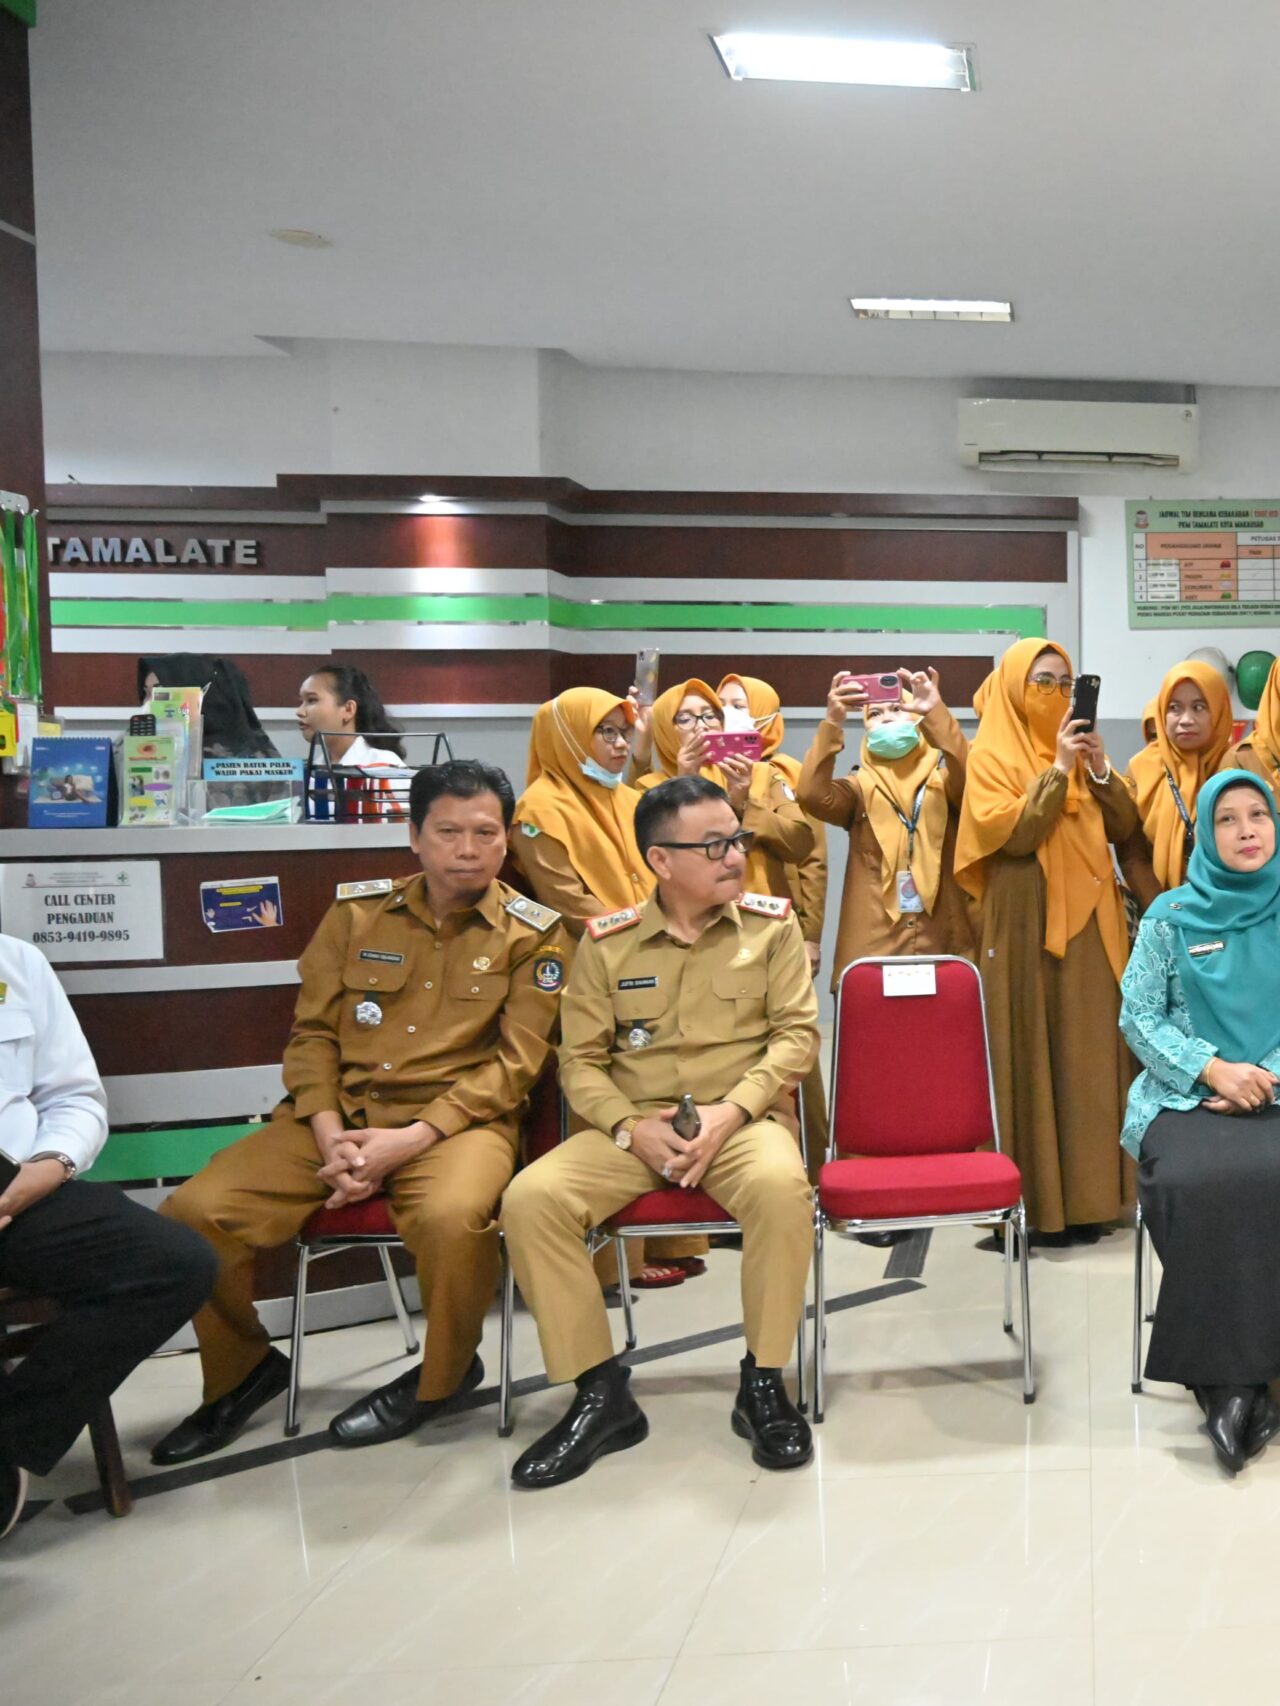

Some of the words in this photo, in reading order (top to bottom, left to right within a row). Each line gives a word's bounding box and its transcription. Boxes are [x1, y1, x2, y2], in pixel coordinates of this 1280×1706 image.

[47, 537, 258, 564] TAMALATE
[44, 895, 70, 906] CALL
[74, 894, 115, 906] CENTER
[47, 912, 114, 924] PENGADUAN
[33, 930, 129, 943] 0853-9419-9895
